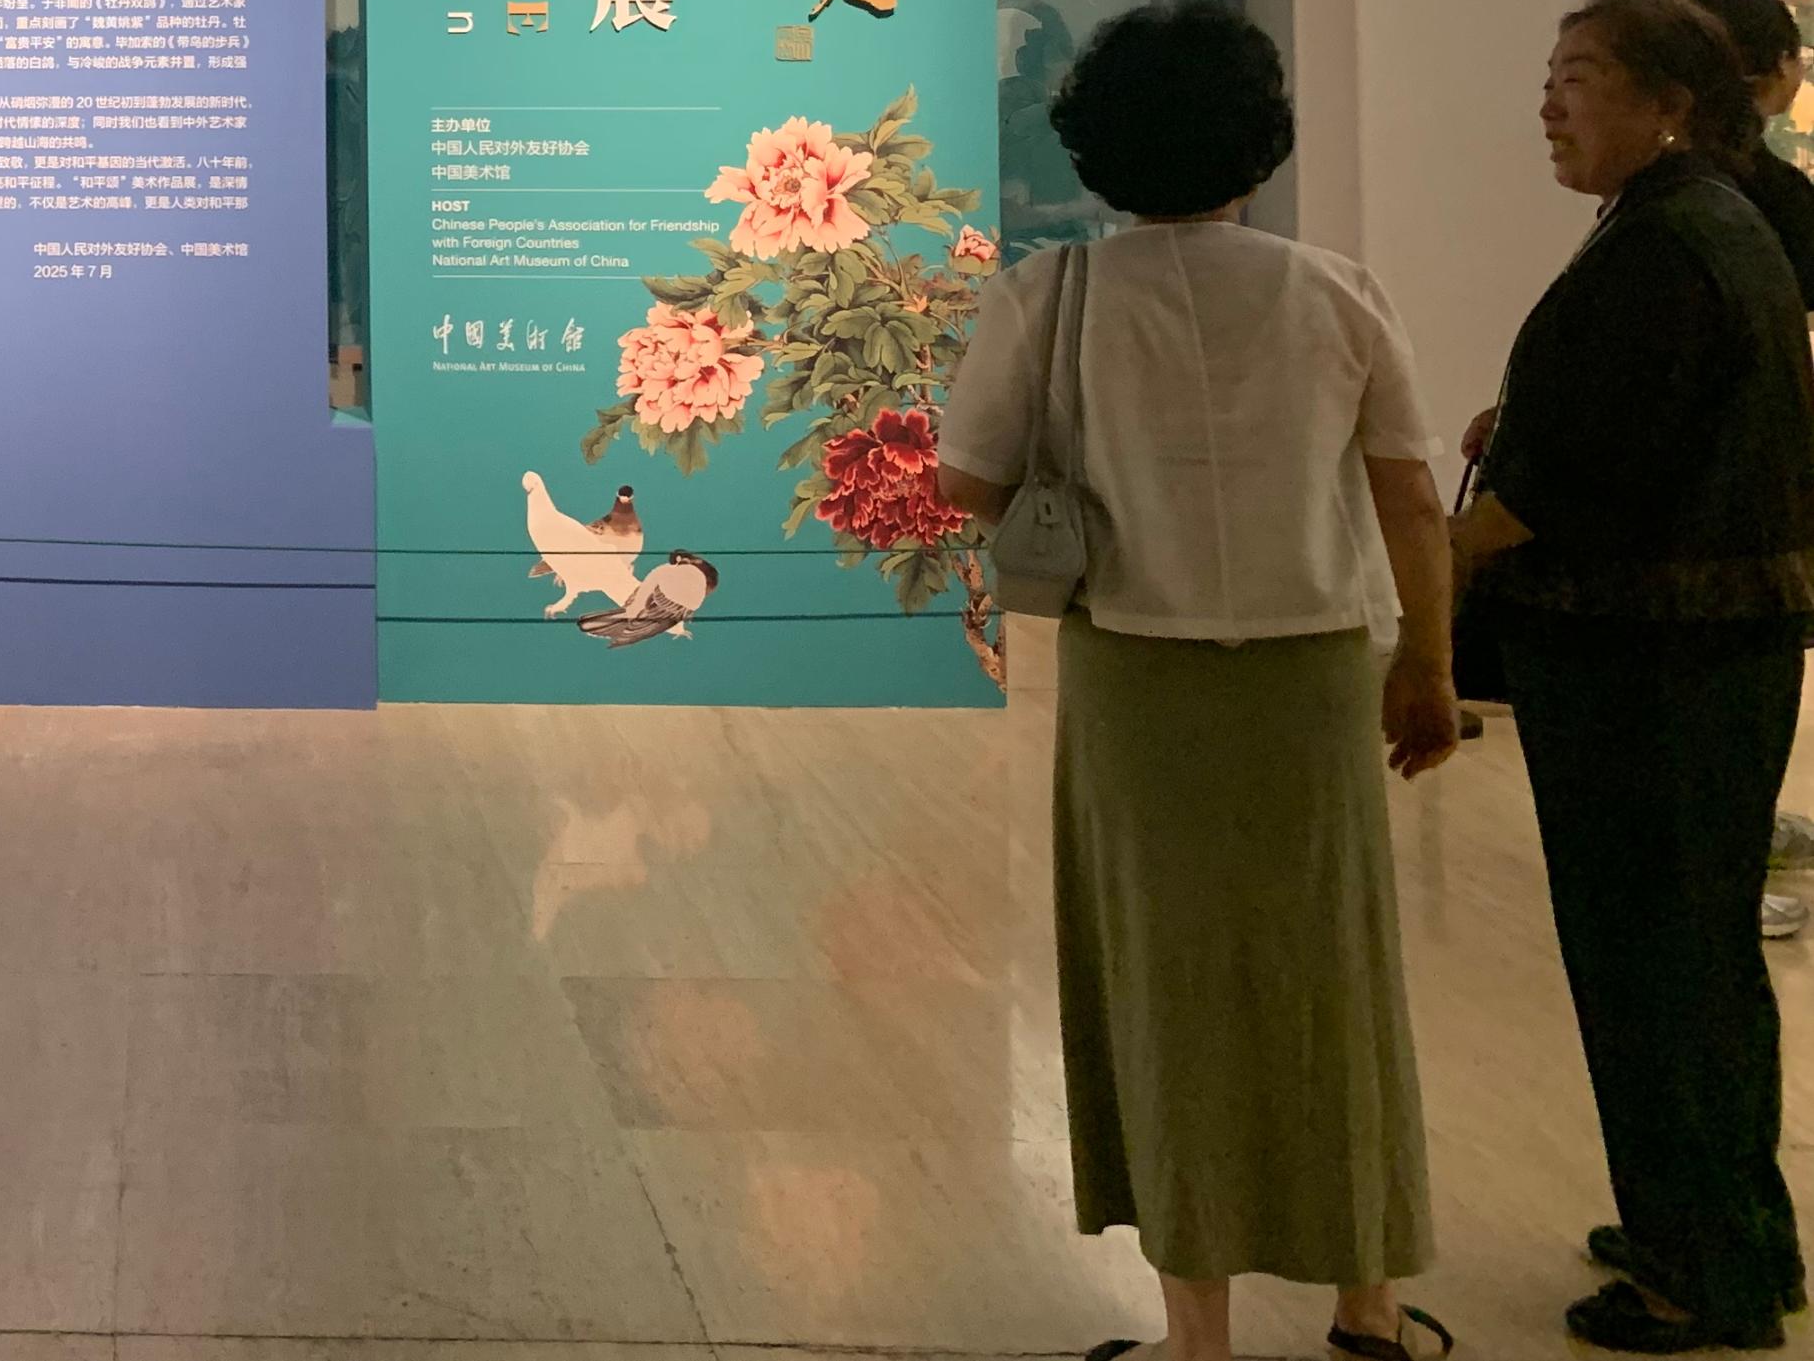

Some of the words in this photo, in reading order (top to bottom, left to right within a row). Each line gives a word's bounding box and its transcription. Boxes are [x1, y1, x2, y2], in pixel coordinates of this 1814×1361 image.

[431, 118, 491, 133] 主办单位
[431, 140, 590, 156] 中国人民对外友好协会
[431, 164, 511, 181] 中国美术馆
[431, 200, 470, 213] HOST
[431, 218, 485, 231] Chinese
[489, 218, 545, 233] People's
[548, 218, 625, 231] Association
[628, 218, 646, 231] for
[650, 218, 720, 234] Friendship
[431, 236, 459, 249] with
[462, 237, 512, 251] Foreign
[516, 236, 580, 249] Countries
[431, 254, 487, 267] National
[489, 254, 510, 267] Art
[513, 255, 570, 267] Museum
[573, 254, 587, 267] of
[590, 255, 629, 268] China
